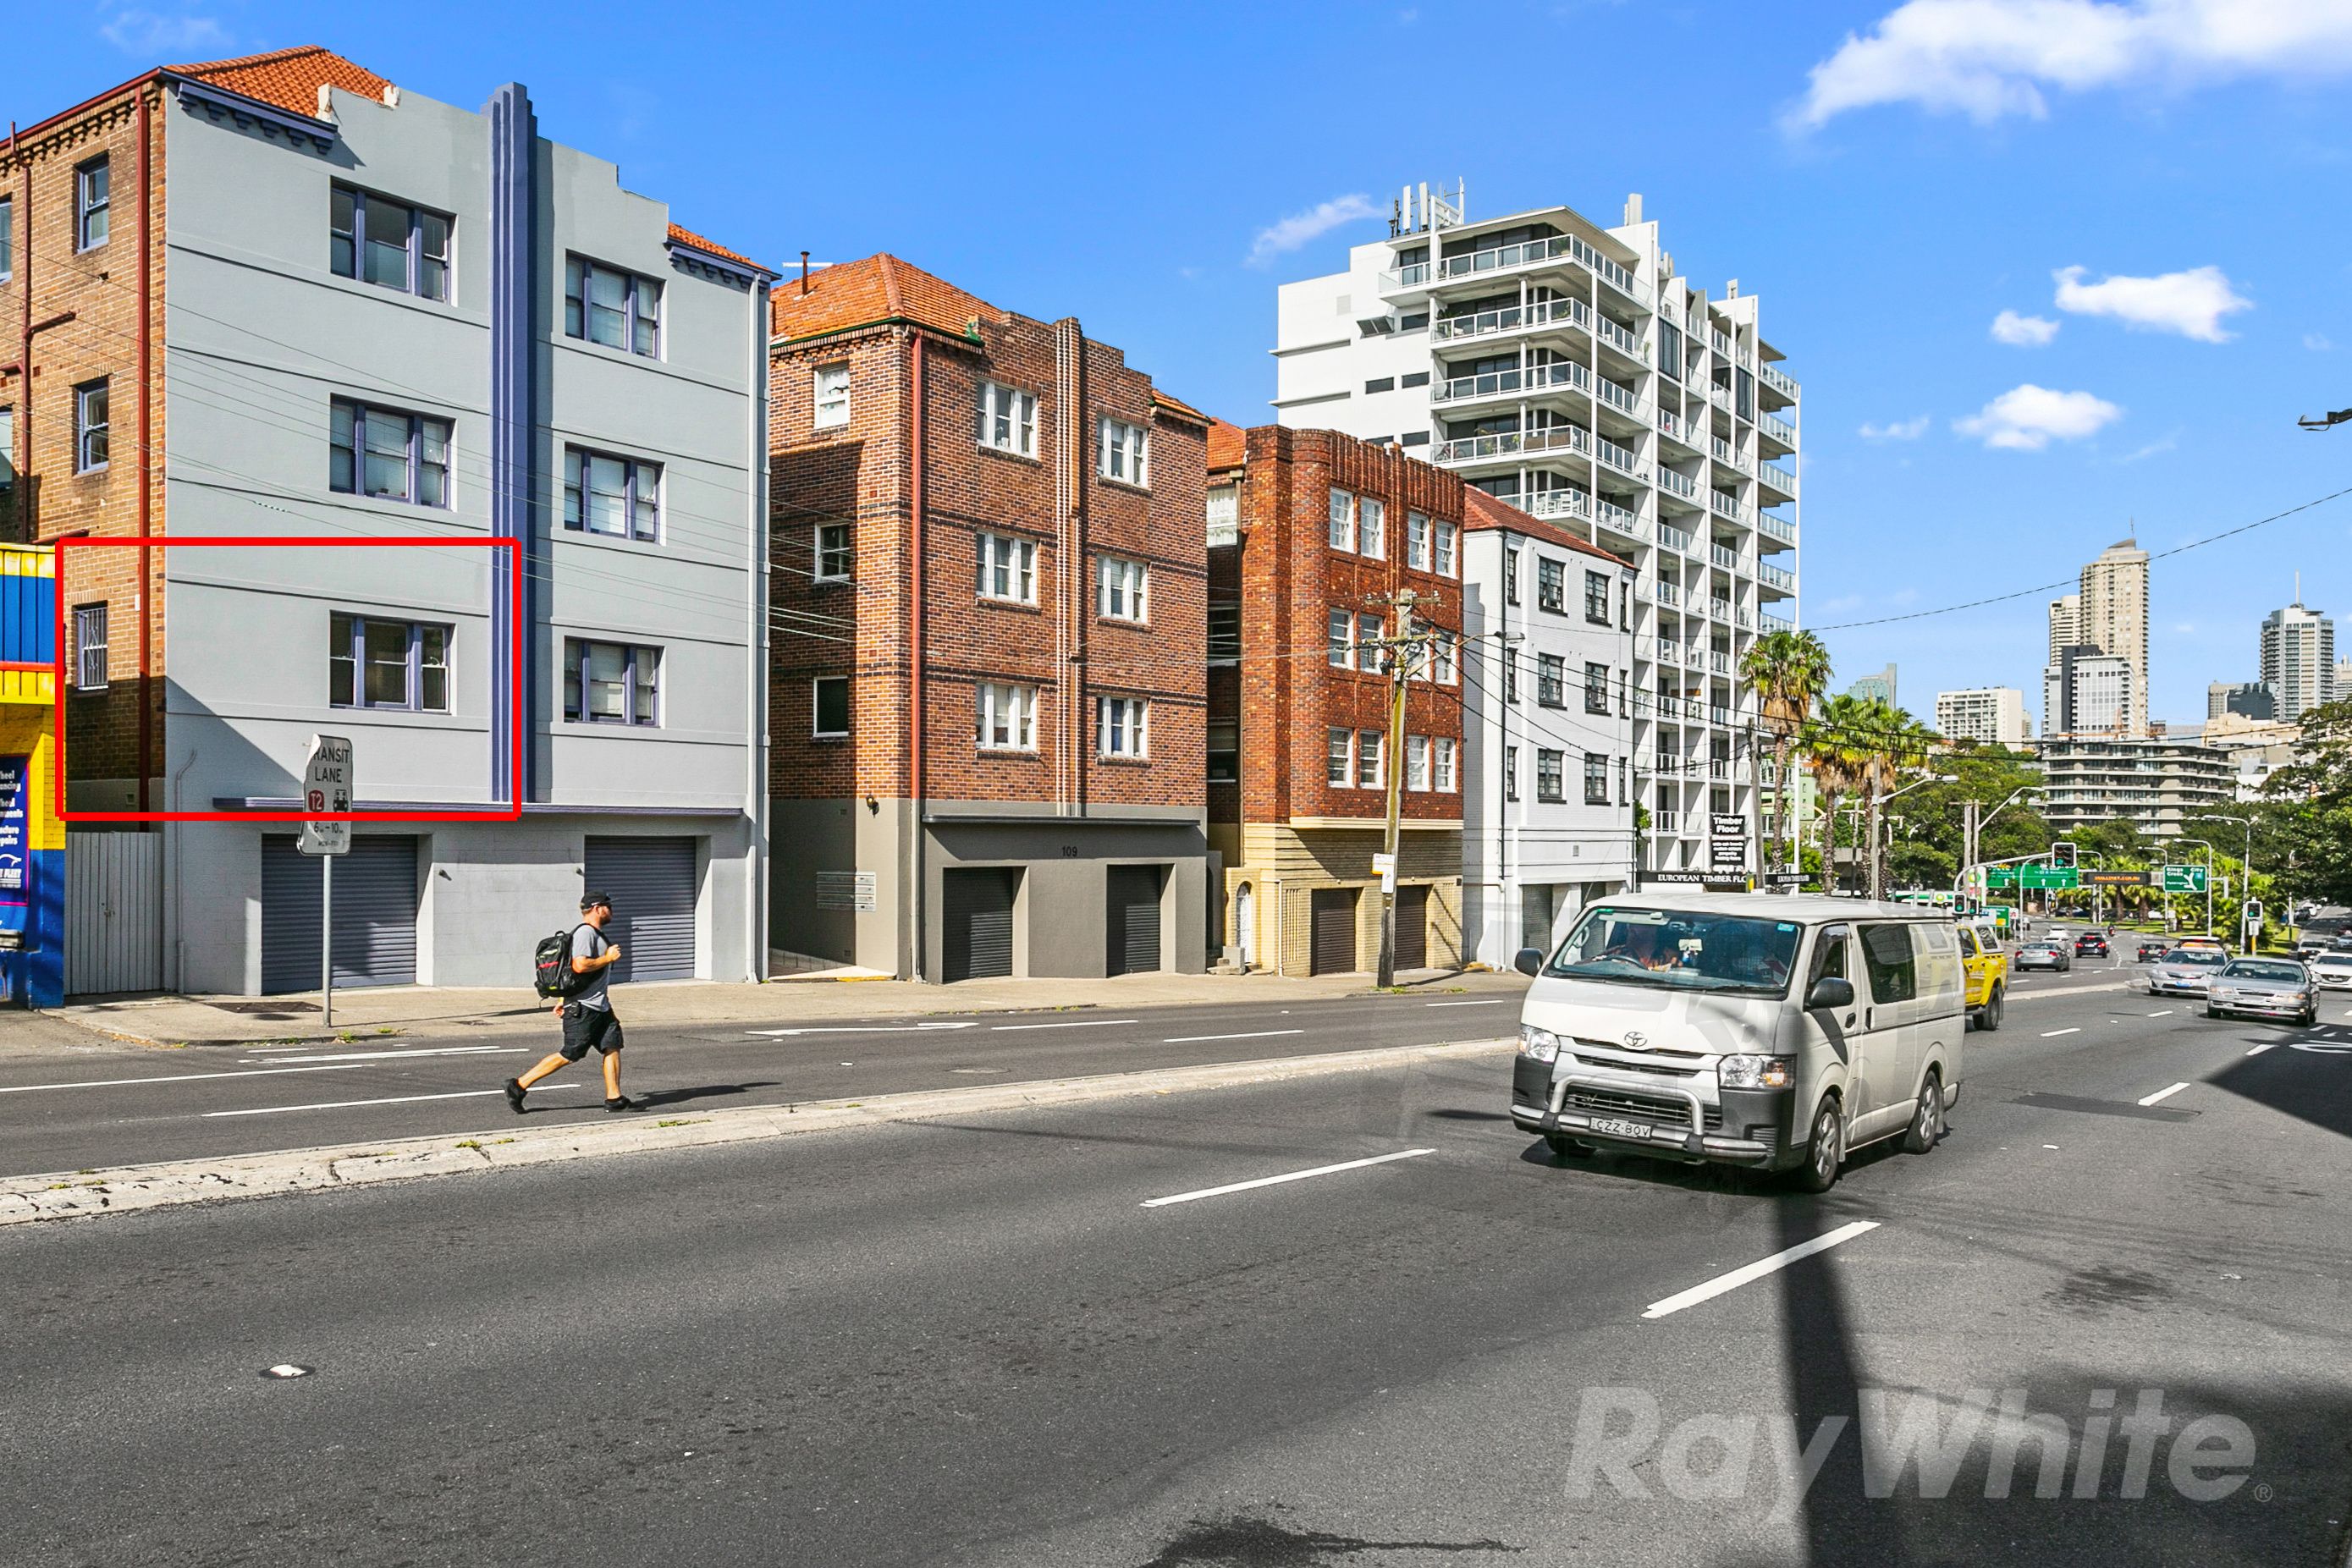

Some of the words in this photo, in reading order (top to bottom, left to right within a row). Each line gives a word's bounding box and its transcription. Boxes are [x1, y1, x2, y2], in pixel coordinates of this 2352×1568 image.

[313, 746, 350, 763] RANSIT
[315, 767, 343, 783] LANE
[311, 793, 322, 810] T2
[1713, 817, 1743, 825] Timber
[1061, 845, 1078, 857] 109
